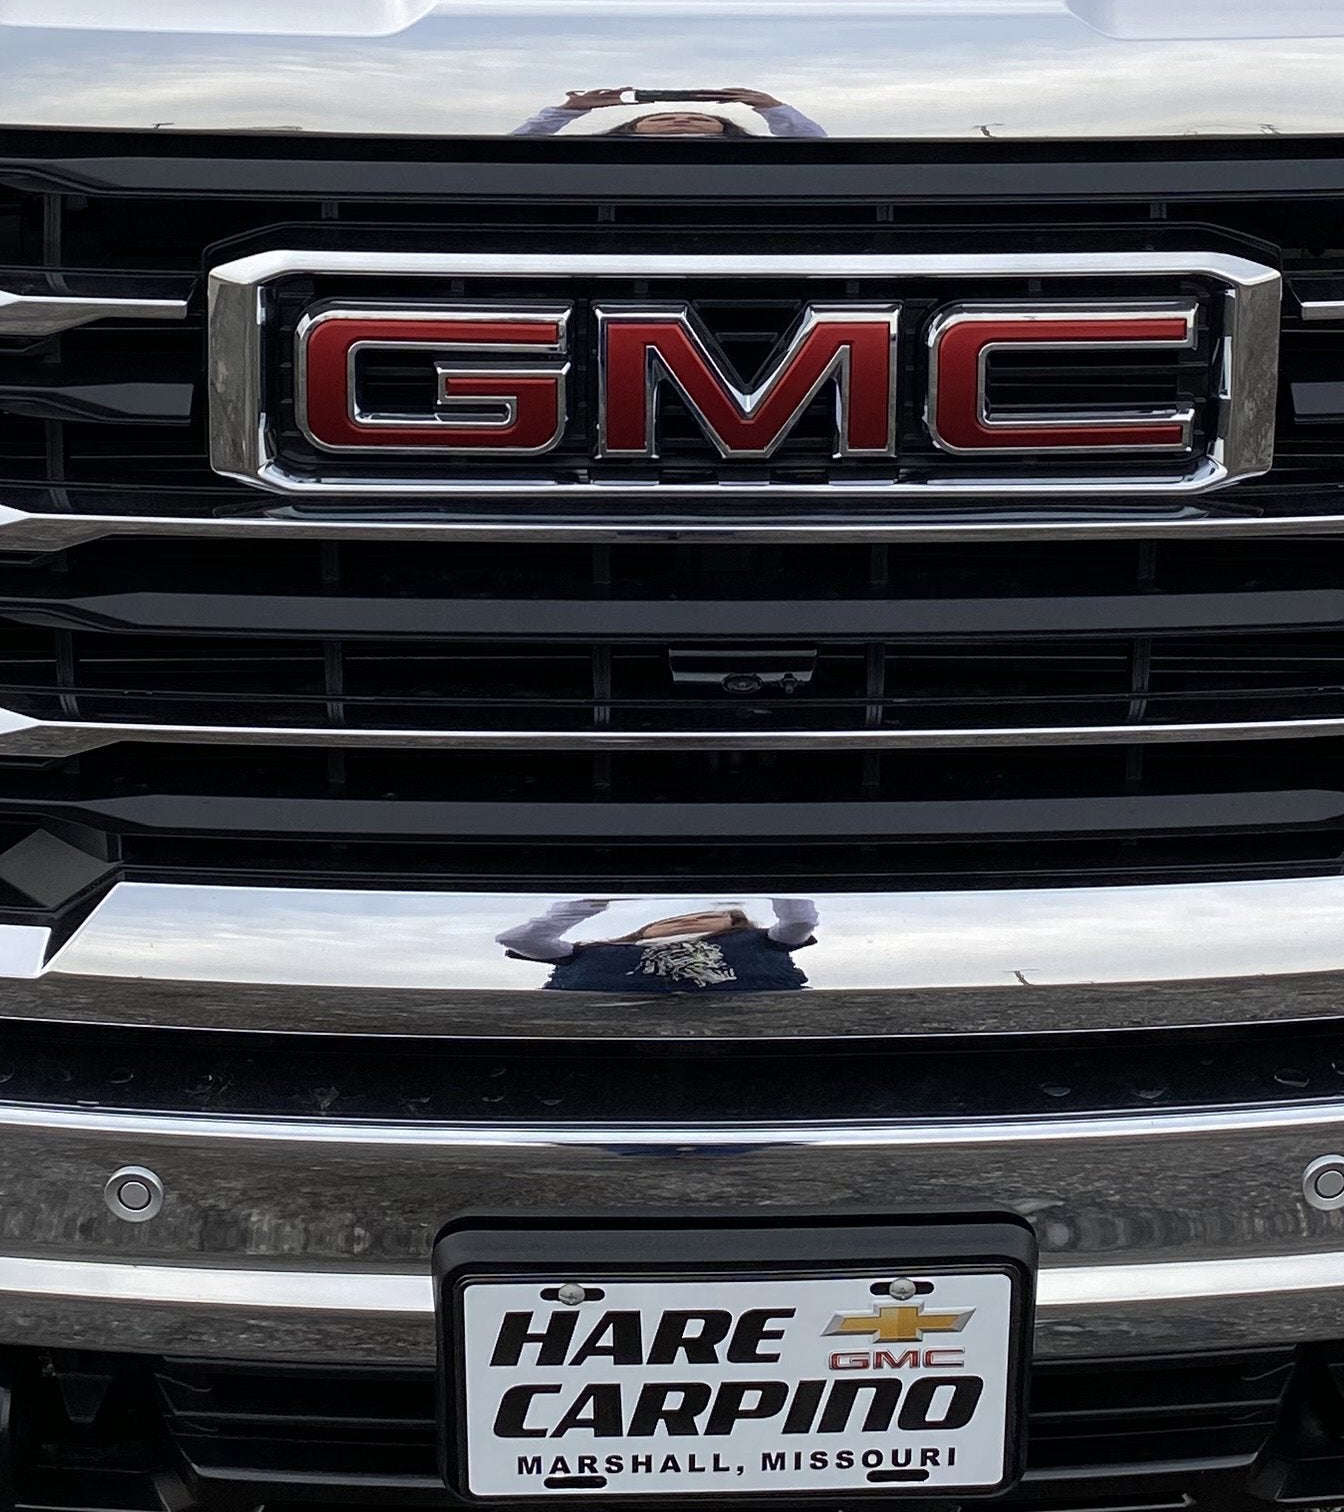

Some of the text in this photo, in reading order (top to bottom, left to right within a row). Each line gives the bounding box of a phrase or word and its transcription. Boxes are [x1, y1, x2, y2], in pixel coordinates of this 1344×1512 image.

[295, 298, 1200, 461] GMC
[489, 1307, 797, 1368] HARE
[827, 1345, 966, 1372] GMC
[492, 1375, 984, 1439] CARPINO
[517, 1445, 958, 1478] MARSHALL, MISSOURI
